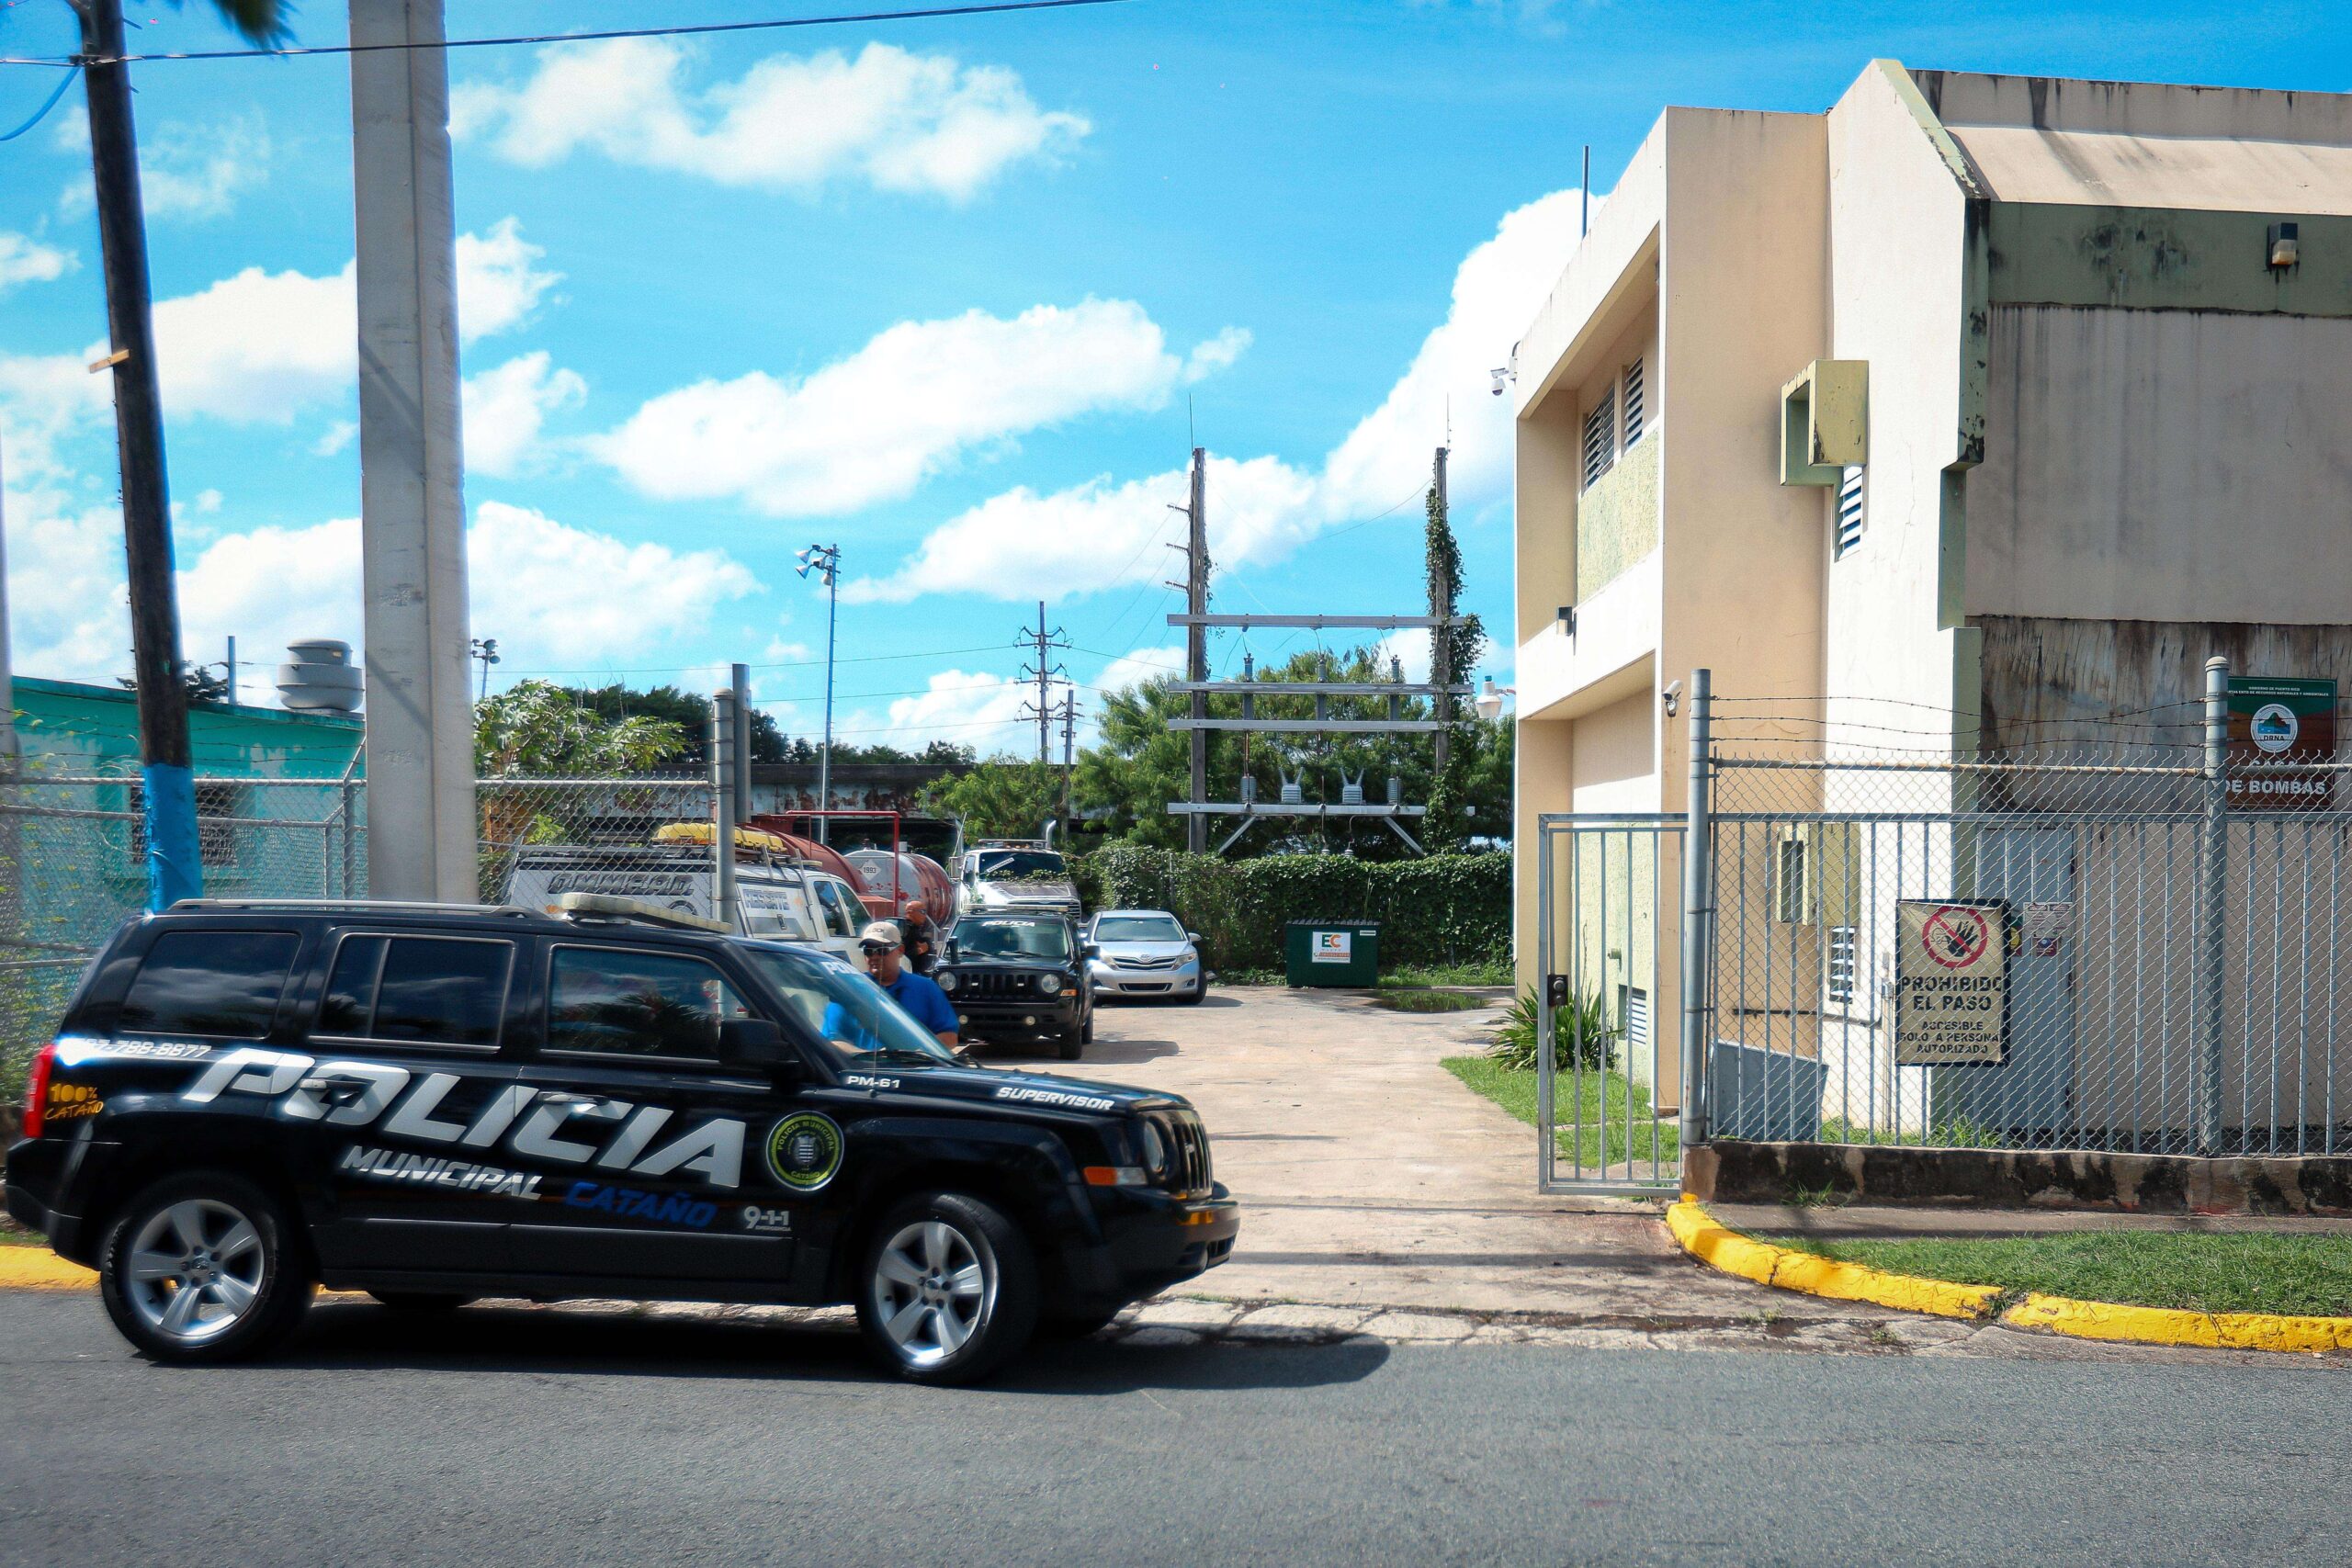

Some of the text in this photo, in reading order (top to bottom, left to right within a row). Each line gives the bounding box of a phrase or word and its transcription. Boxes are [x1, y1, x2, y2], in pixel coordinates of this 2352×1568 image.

[2248, 780, 2325, 795] BOMBAS
[1913, 996, 1992, 1011] EL PASO
[1921, 1021, 1984, 1031] ACCESIBLE
[1900, 1032, 1929, 1042] SOLO
[1936, 1032, 1943, 1042] A
[1916, 1044, 1988, 1054] AUTORIZADO
[846, 1076, 900, 1089] PM-61
[51, 1083, 98, 1102] 100%
[997, 1087, 1114, 1111] SUPERVISOR
[183, 1049, 746, 1188] POLICIA
[777, 1122, 800, 1150] POLICIA
[341, 1145, 718, 1228] MUNICIPAL CATAÑO
[743, 1205, 789, 1229] 9-1-1
